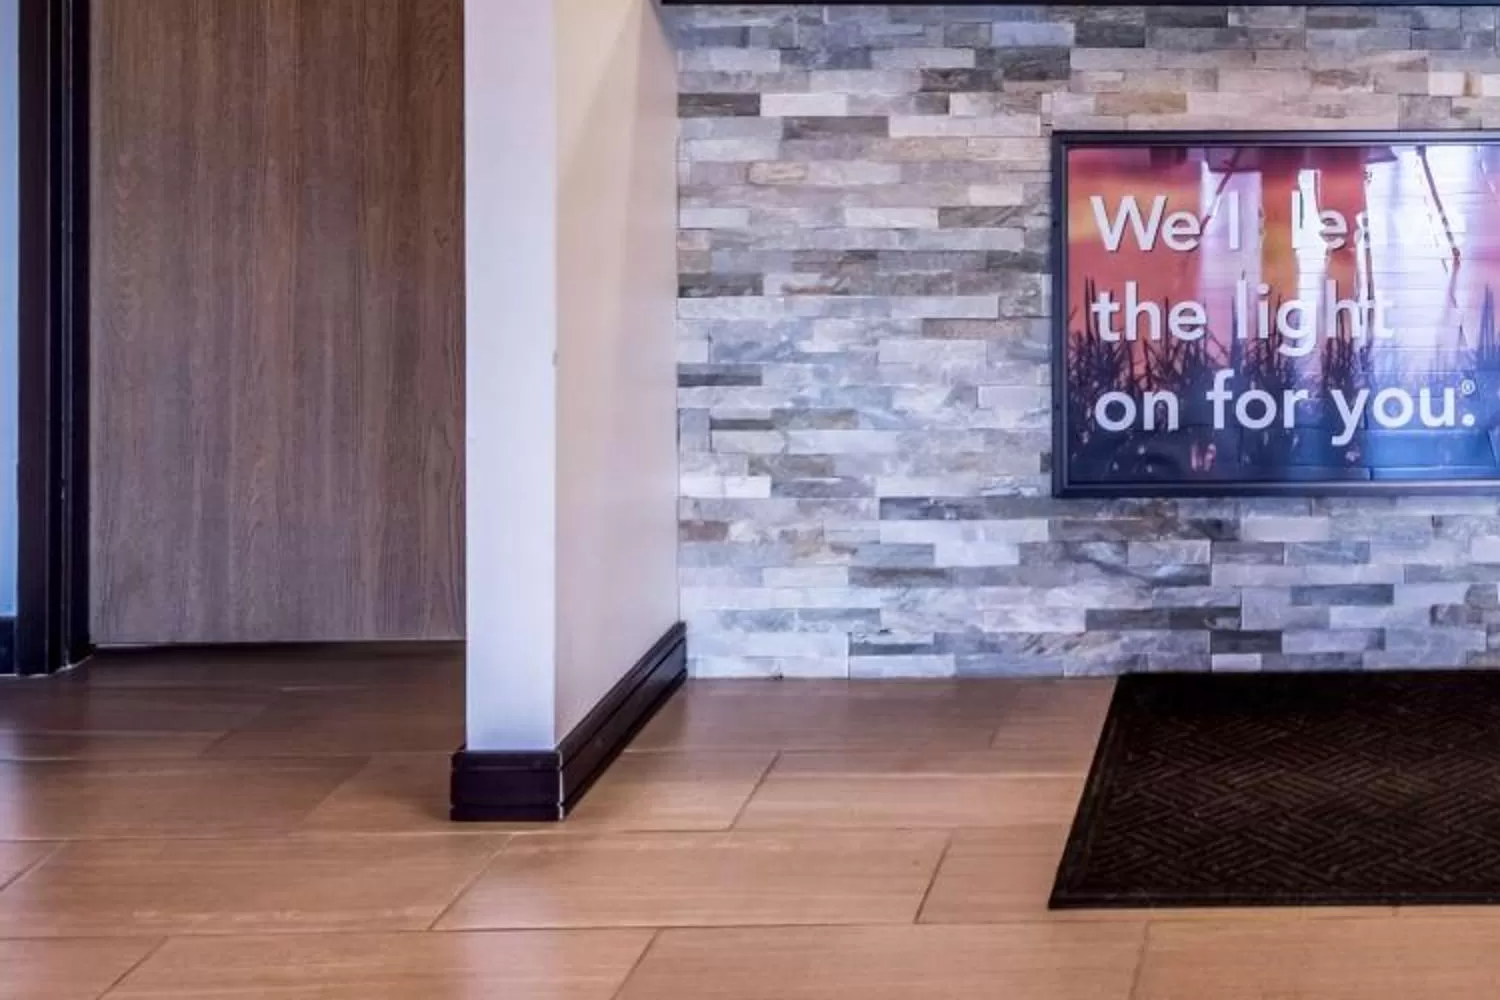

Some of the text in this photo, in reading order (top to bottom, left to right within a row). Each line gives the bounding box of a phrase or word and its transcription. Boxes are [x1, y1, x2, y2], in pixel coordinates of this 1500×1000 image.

[1092, 279, 1394, 356] the light
[1095, 389, 1178, 431] on
[1206, 369, 1308, 430] for
